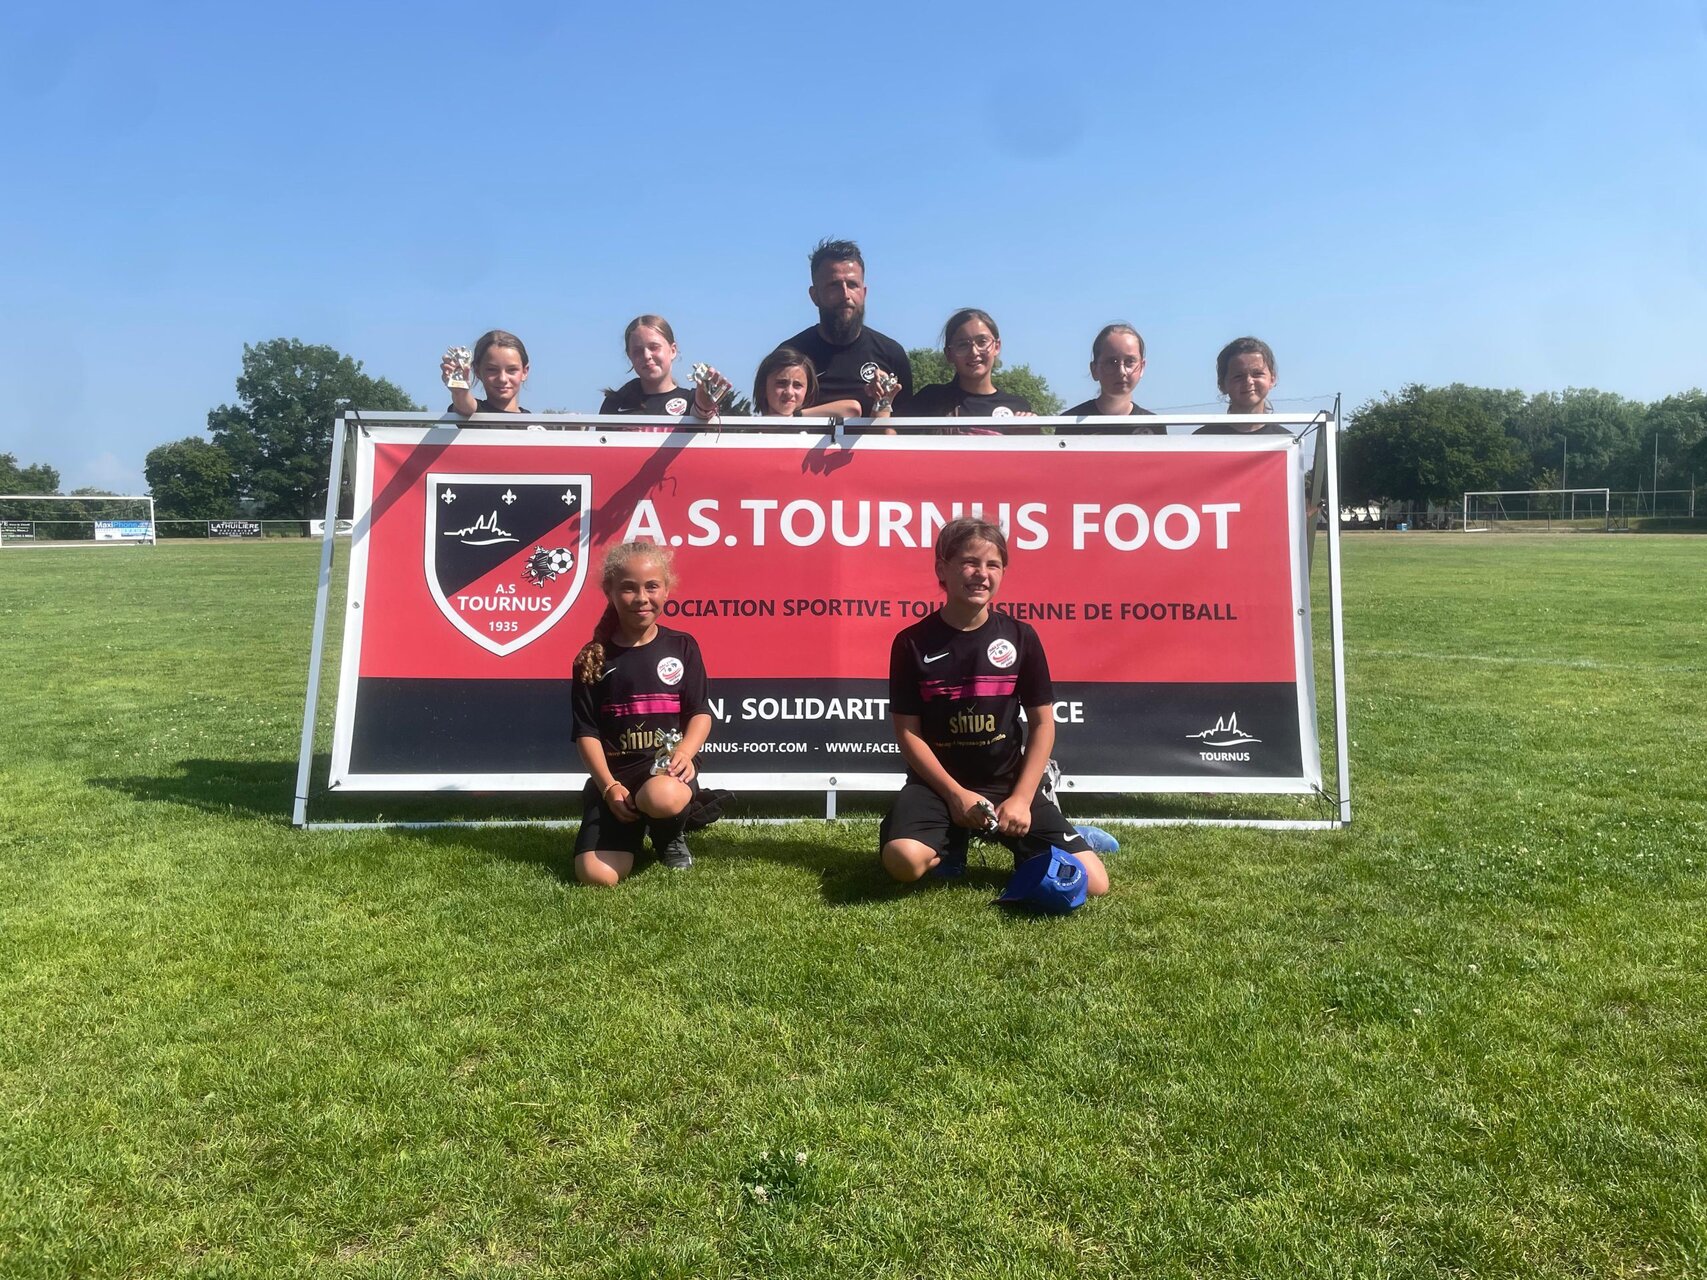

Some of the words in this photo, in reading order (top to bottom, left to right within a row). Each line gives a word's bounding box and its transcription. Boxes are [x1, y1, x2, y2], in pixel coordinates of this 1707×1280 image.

[1072, 502, 1241, 551] FOOT
[496, 584, 516, 594] A.S
[457, 596, 552, 613] TOURNUS
[782, 599, 893, 619] SPORTIVE
[1084, 603, 1113, 620] DE
[1120, 603, 1238, 621] FOOTBALL
[488, 621, 519, 633] 1935
[741, 697, 891, 721] SOLIDARIT
[948, 703, 996, 734] shiva
[1199, 751, 1251, 762] TOURNUS
